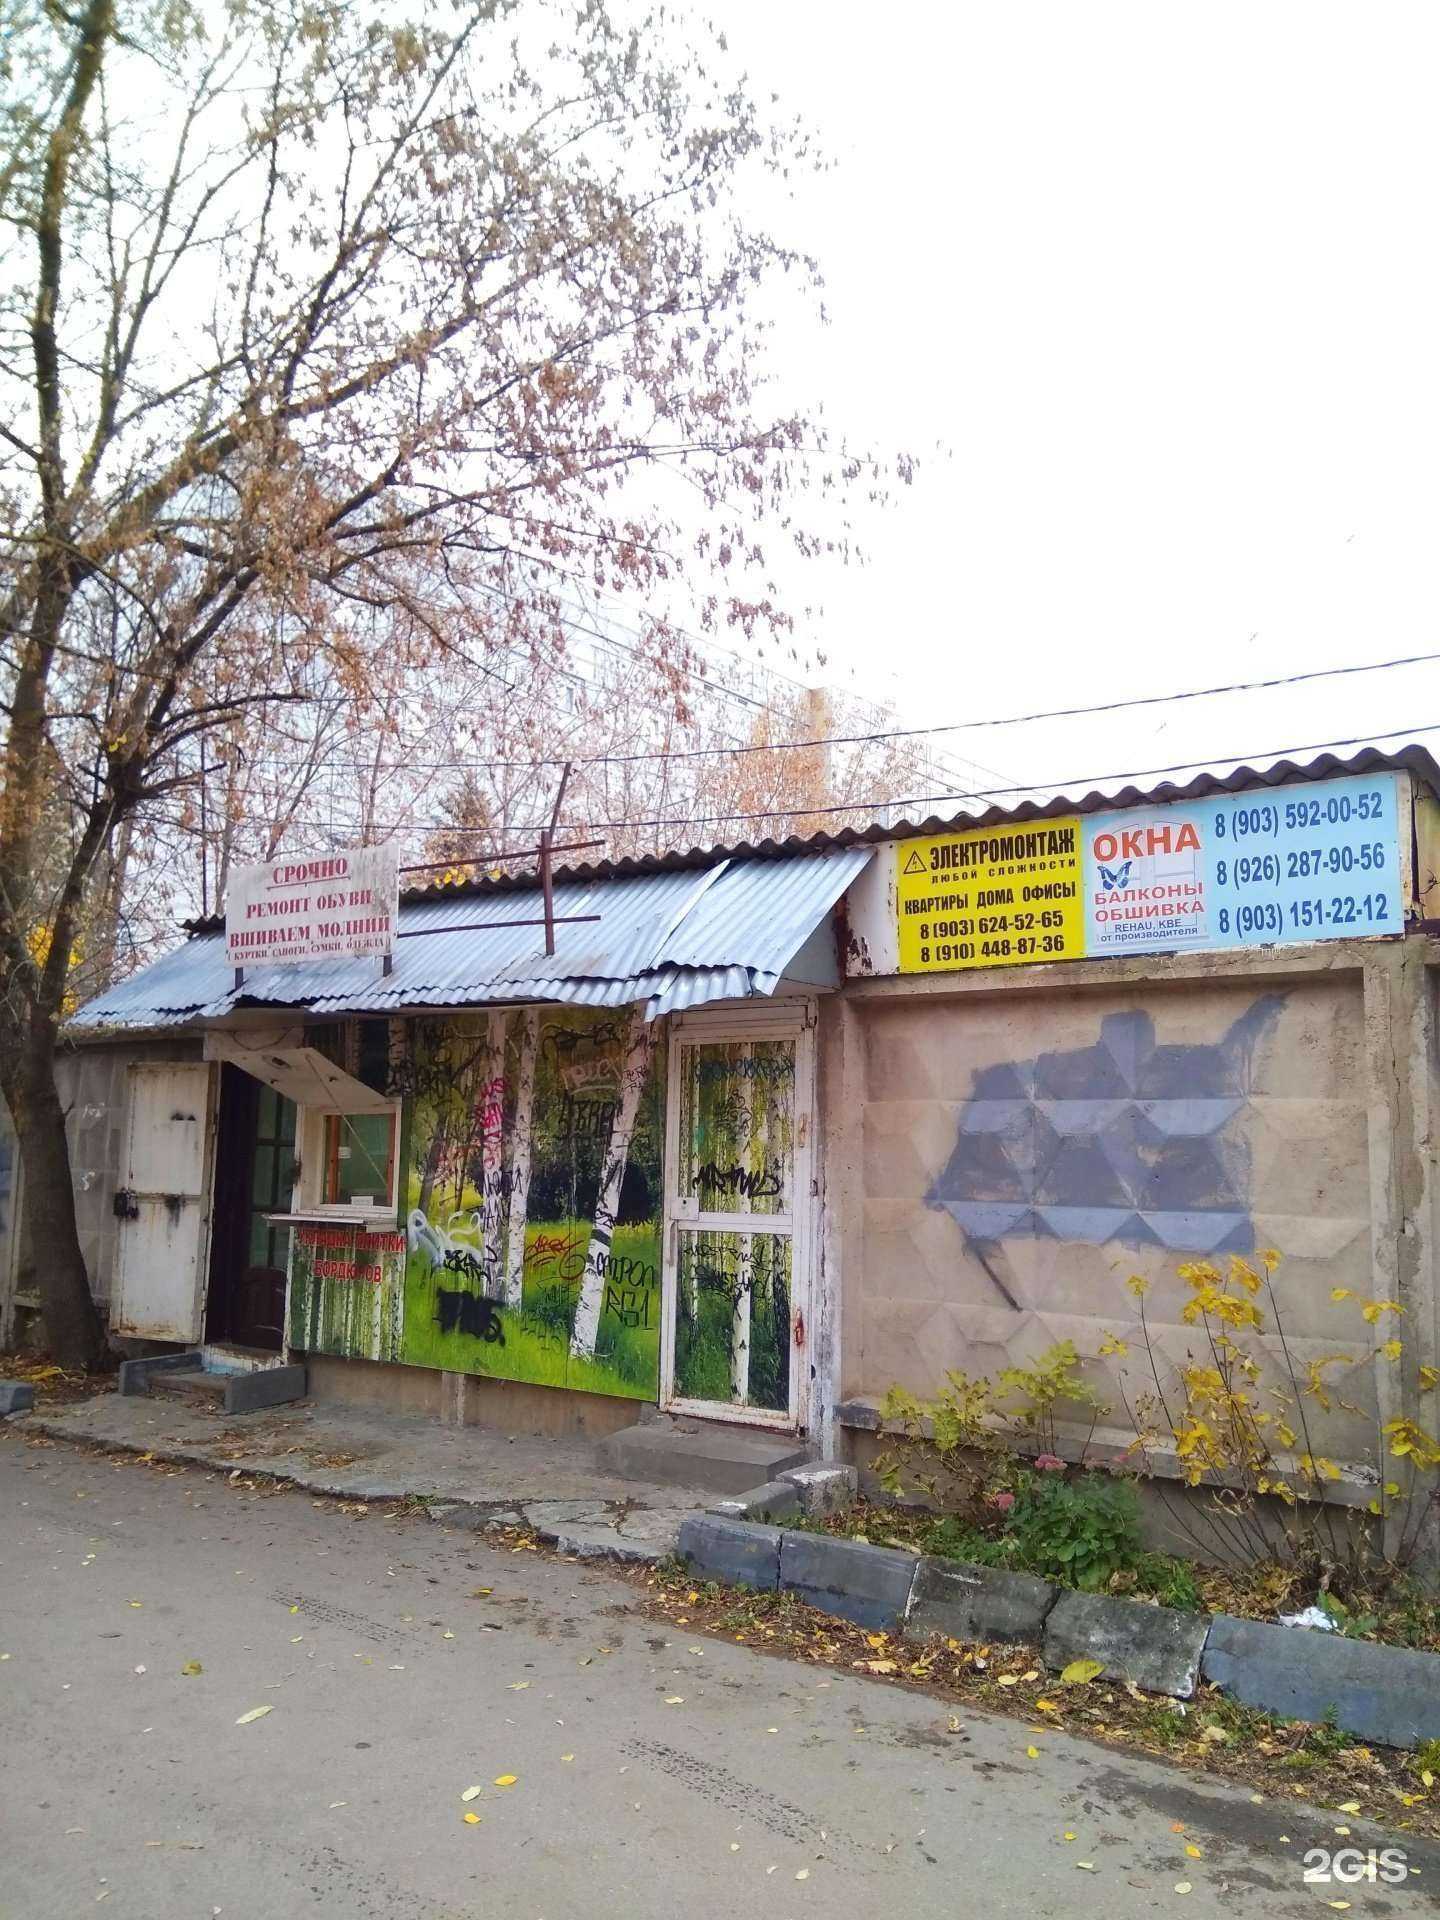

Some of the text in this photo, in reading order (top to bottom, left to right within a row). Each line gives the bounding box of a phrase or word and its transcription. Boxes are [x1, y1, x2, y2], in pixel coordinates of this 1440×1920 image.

[1215, 792, 1382, 842] 8 (903) 592-00-52
[930, 828, 1074, 870] ЭЛЕКТРОМОНТАЖ
[1093, 823, 1201, 861] ОКНА
[273, 858, 347, 885] СРОЧНО
[932, 858, 1076, 884] ЛЮБОЙ СЛОЖНОСТИ
[1217, 842, 1385, 890] 8 (926) 287-90-56
[246, 889, 372, 919] РЕМОНТ ОБУВИ
[905, 881, 1076, 914] КВАРТИРЫ ДОМА ОФИСЫ
[1095, 882, 1203, 905] БАЛКОНЫ
[920, 910, 1063, 939] 8 (903) 624-52-65
[1095, 901, 1204, 922] ОБШИВКА
[1219, 893, 1388, 938] 8 (903) 151-22-12
[230, 916, 389, 948] ВШИВАЕМ МОЛНИИ
[1115, 927, 1198, 942] производителя
[921, 935, 1064, 962] 8 (910) 448-87-36
[313, 1259, 382, 1283] БОРДЮОВ
